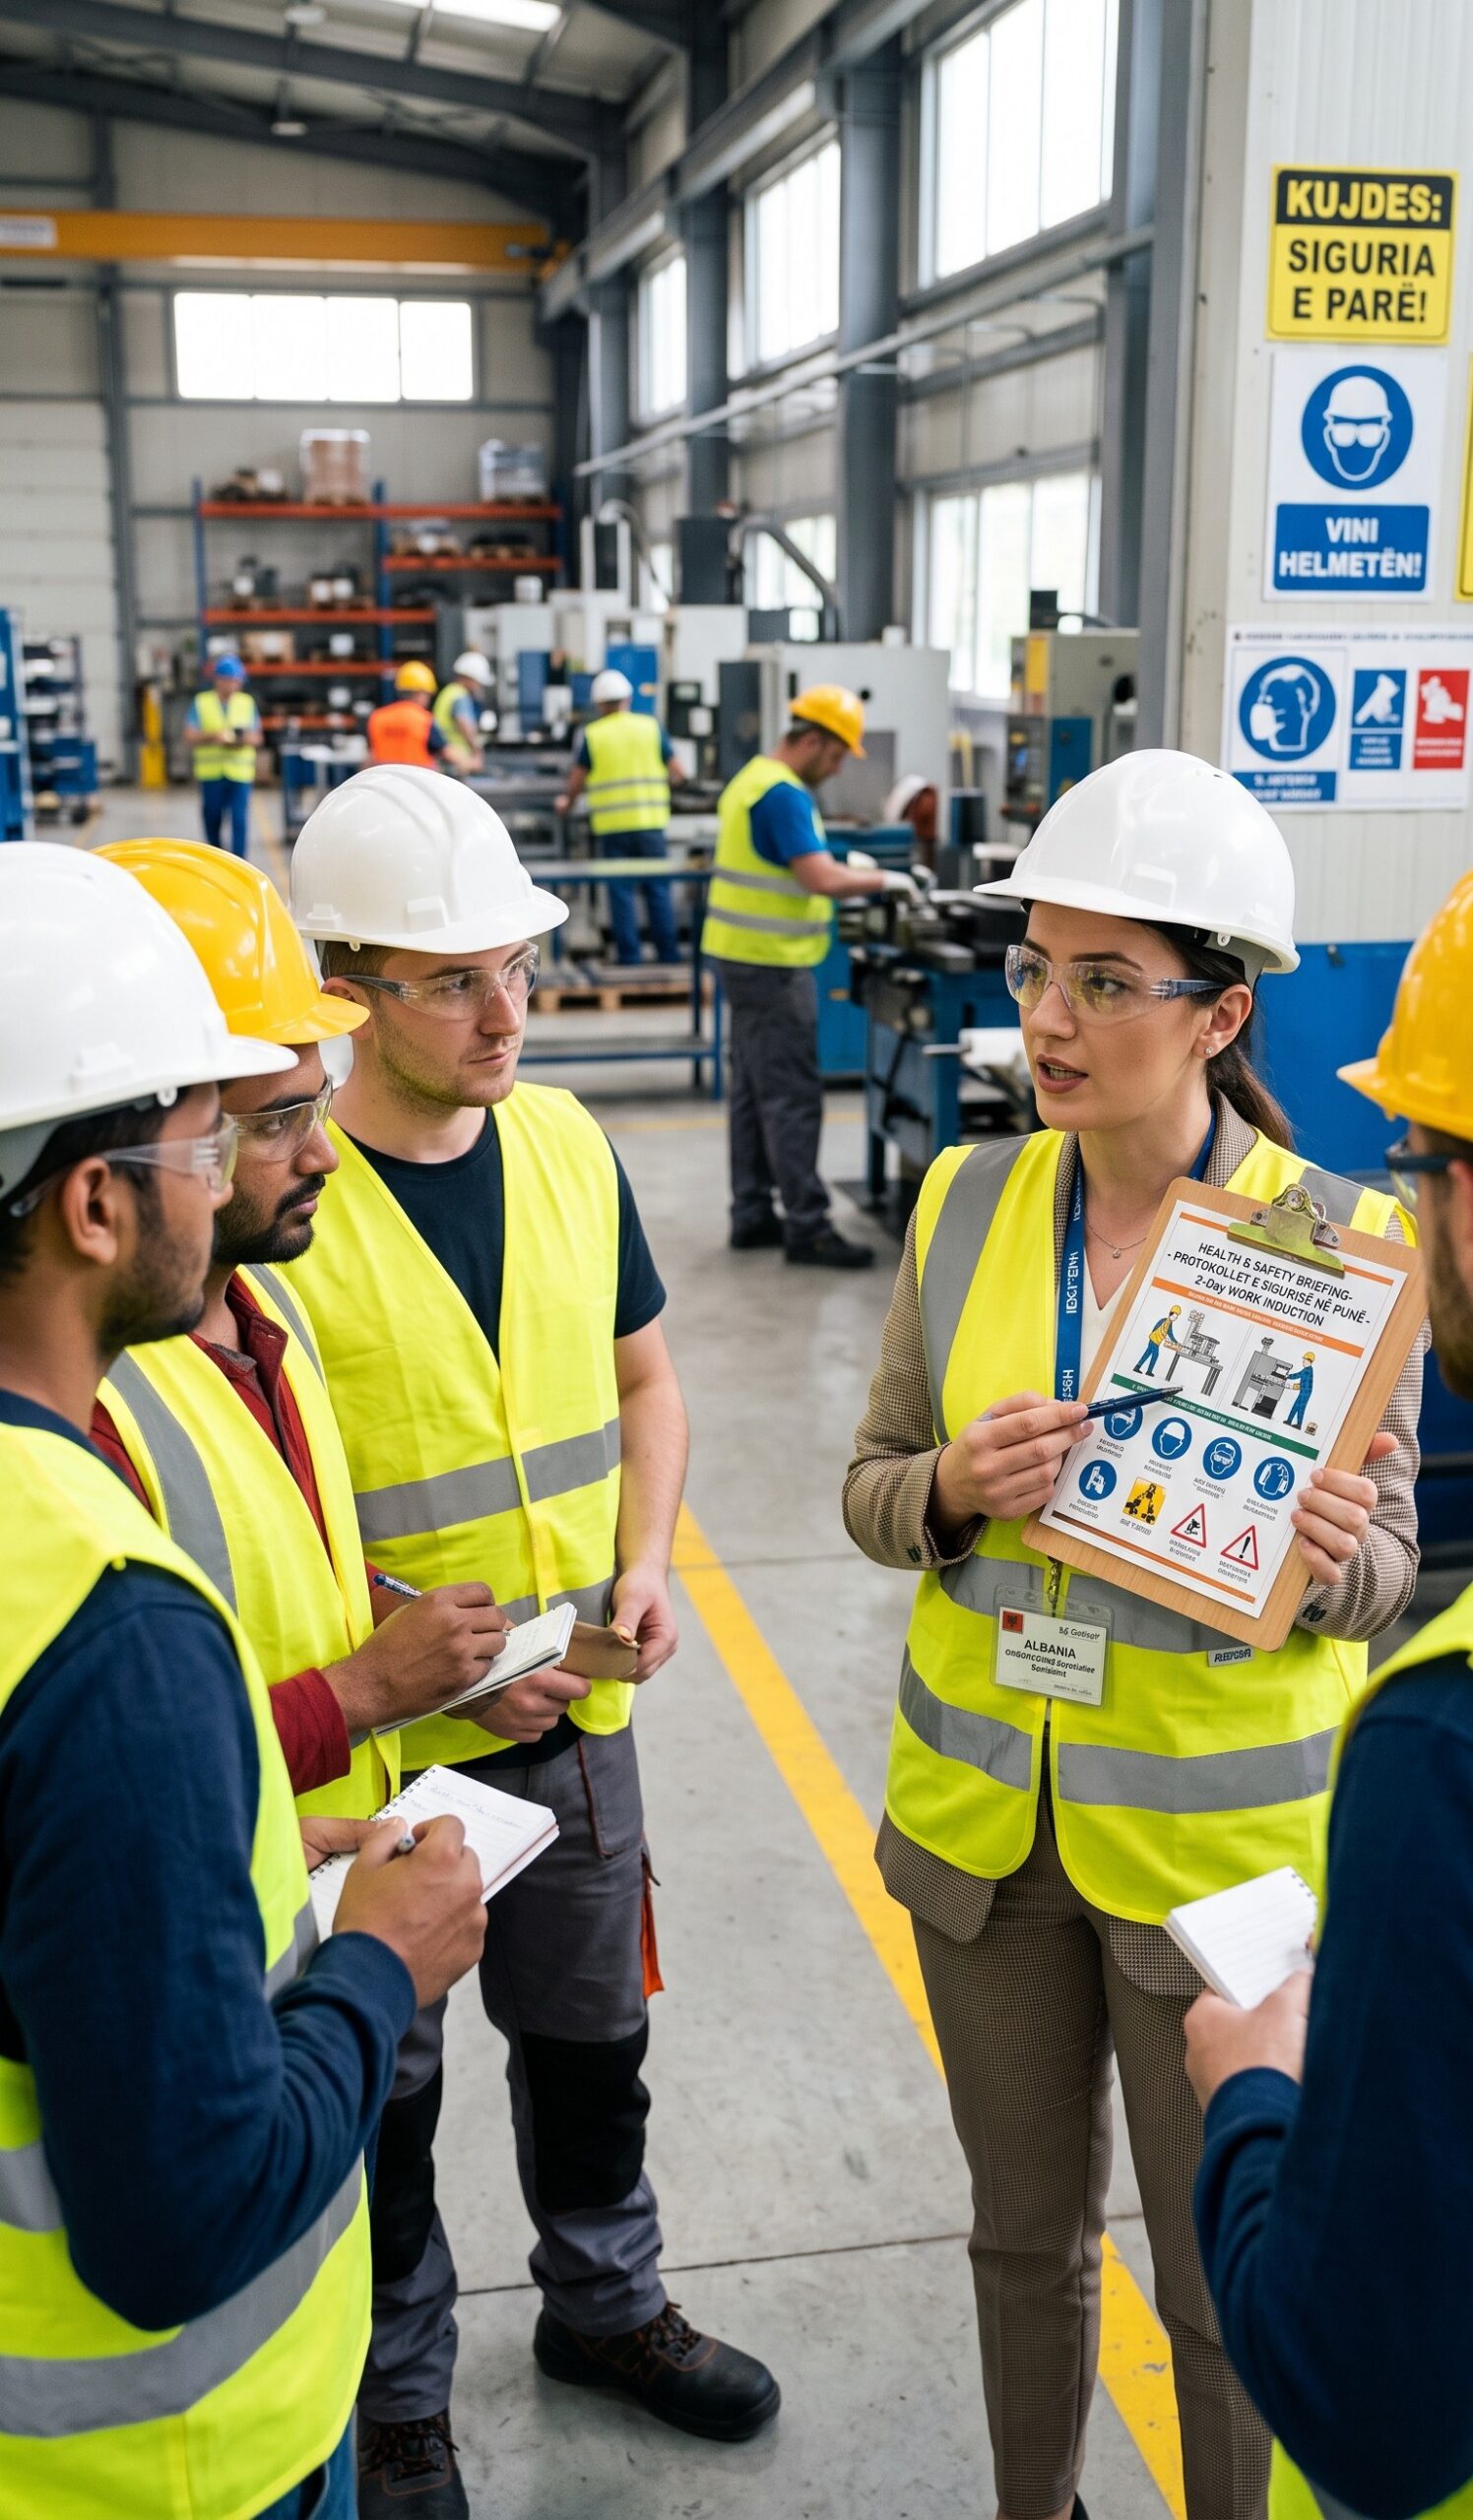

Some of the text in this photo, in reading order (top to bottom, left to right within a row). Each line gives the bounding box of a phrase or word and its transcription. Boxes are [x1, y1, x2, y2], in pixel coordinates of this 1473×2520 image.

[1286, 179, 1442, 222] KUJDES:
[1289, 238, 1435, 277] SIGURIA
[1293, 282, 1426, 323] E PARË!
[1325, 517, 1379, 543] VINI
[1279, 546, 1423, 578] HELMETËN!
[1173, 1251, 1251, 1285] PROTOKOLLET
[1251, 1277, 1260, 1288] E
[1197, 1242, 1243, 1265] HEALTH
[1243, 1257, 1251, 1268] &
[1252, 1261, 1296, 1283] SAFETY
[1194, 1275, 1324, 1326] 2-Day WORK INDUCTION
[1024, 1639, 1076, 1659] ALBANIA
